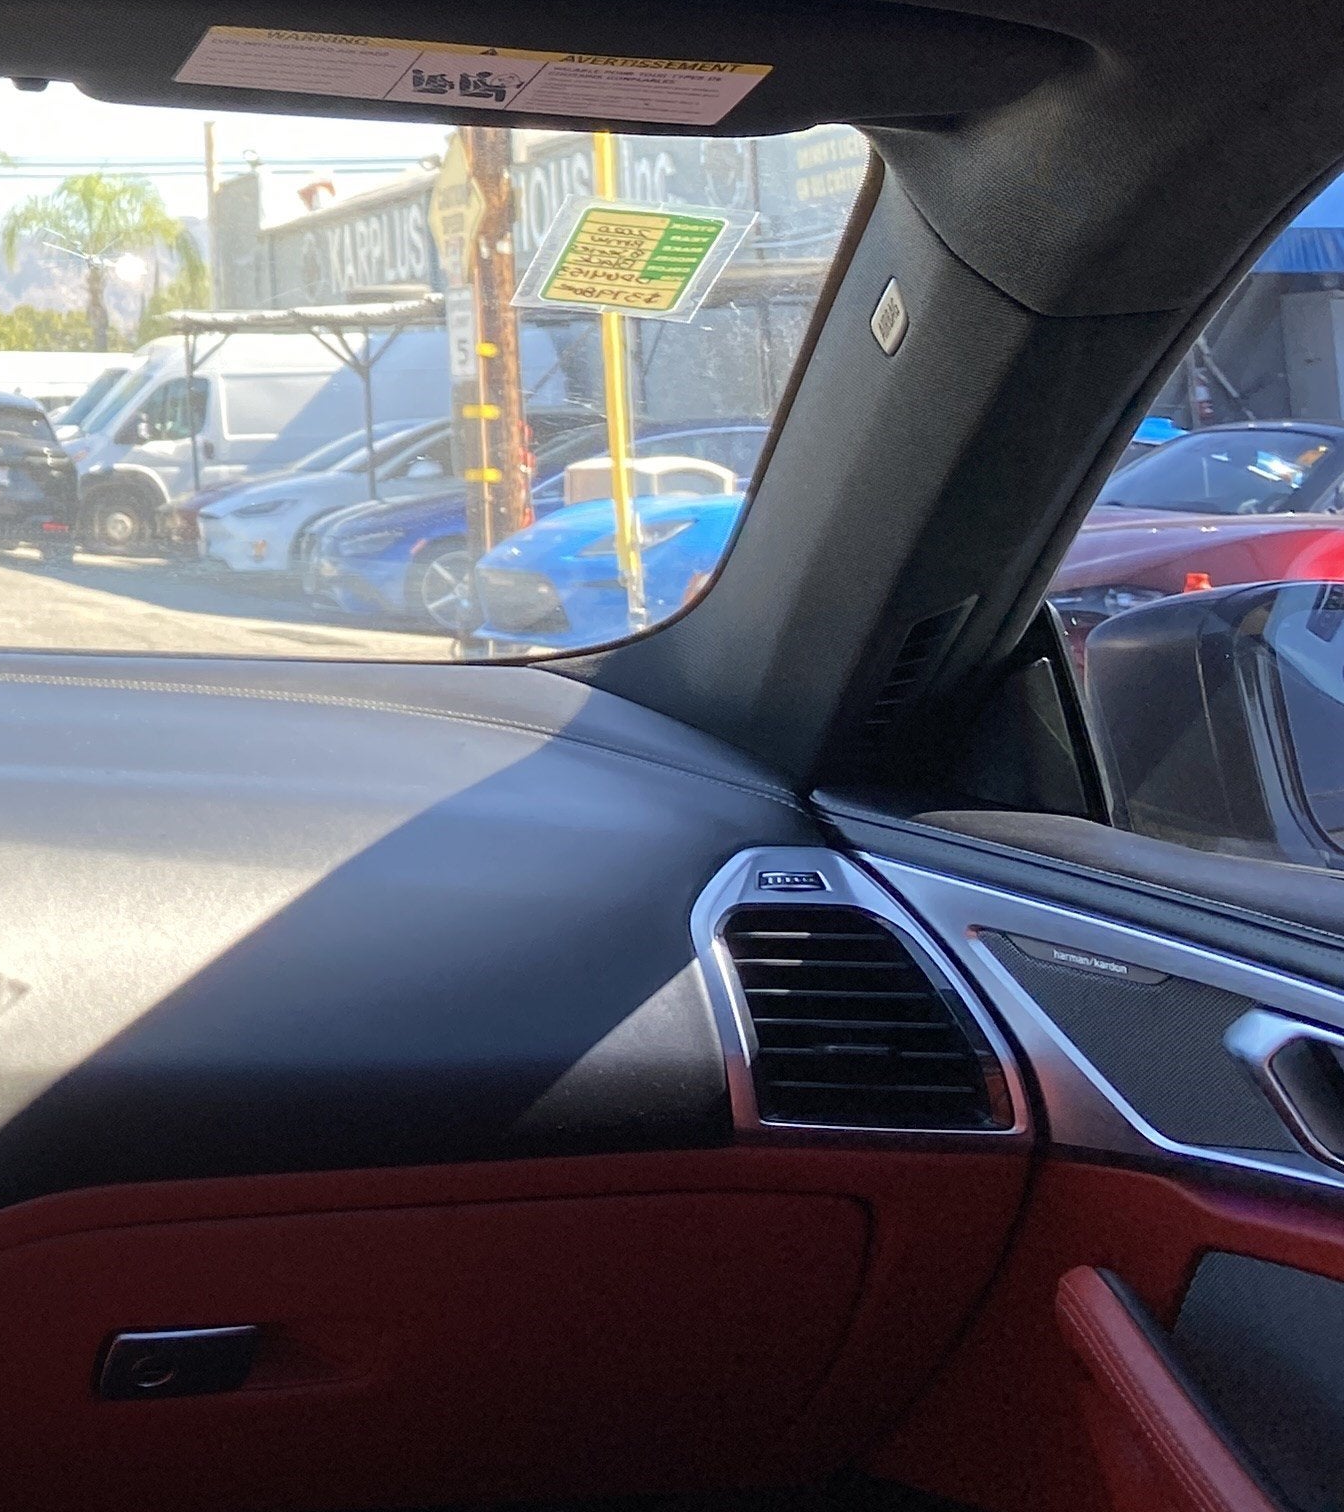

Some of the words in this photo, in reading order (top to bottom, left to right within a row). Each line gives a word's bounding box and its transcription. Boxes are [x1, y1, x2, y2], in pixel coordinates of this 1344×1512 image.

[266, 31, 368, 48] WARNING
[559, 55, 741, 74] AVERTISSEMENT
[327, 202, 428, 297] KARPLUS
[1053, 949, 1128, 974] harman/kardon
